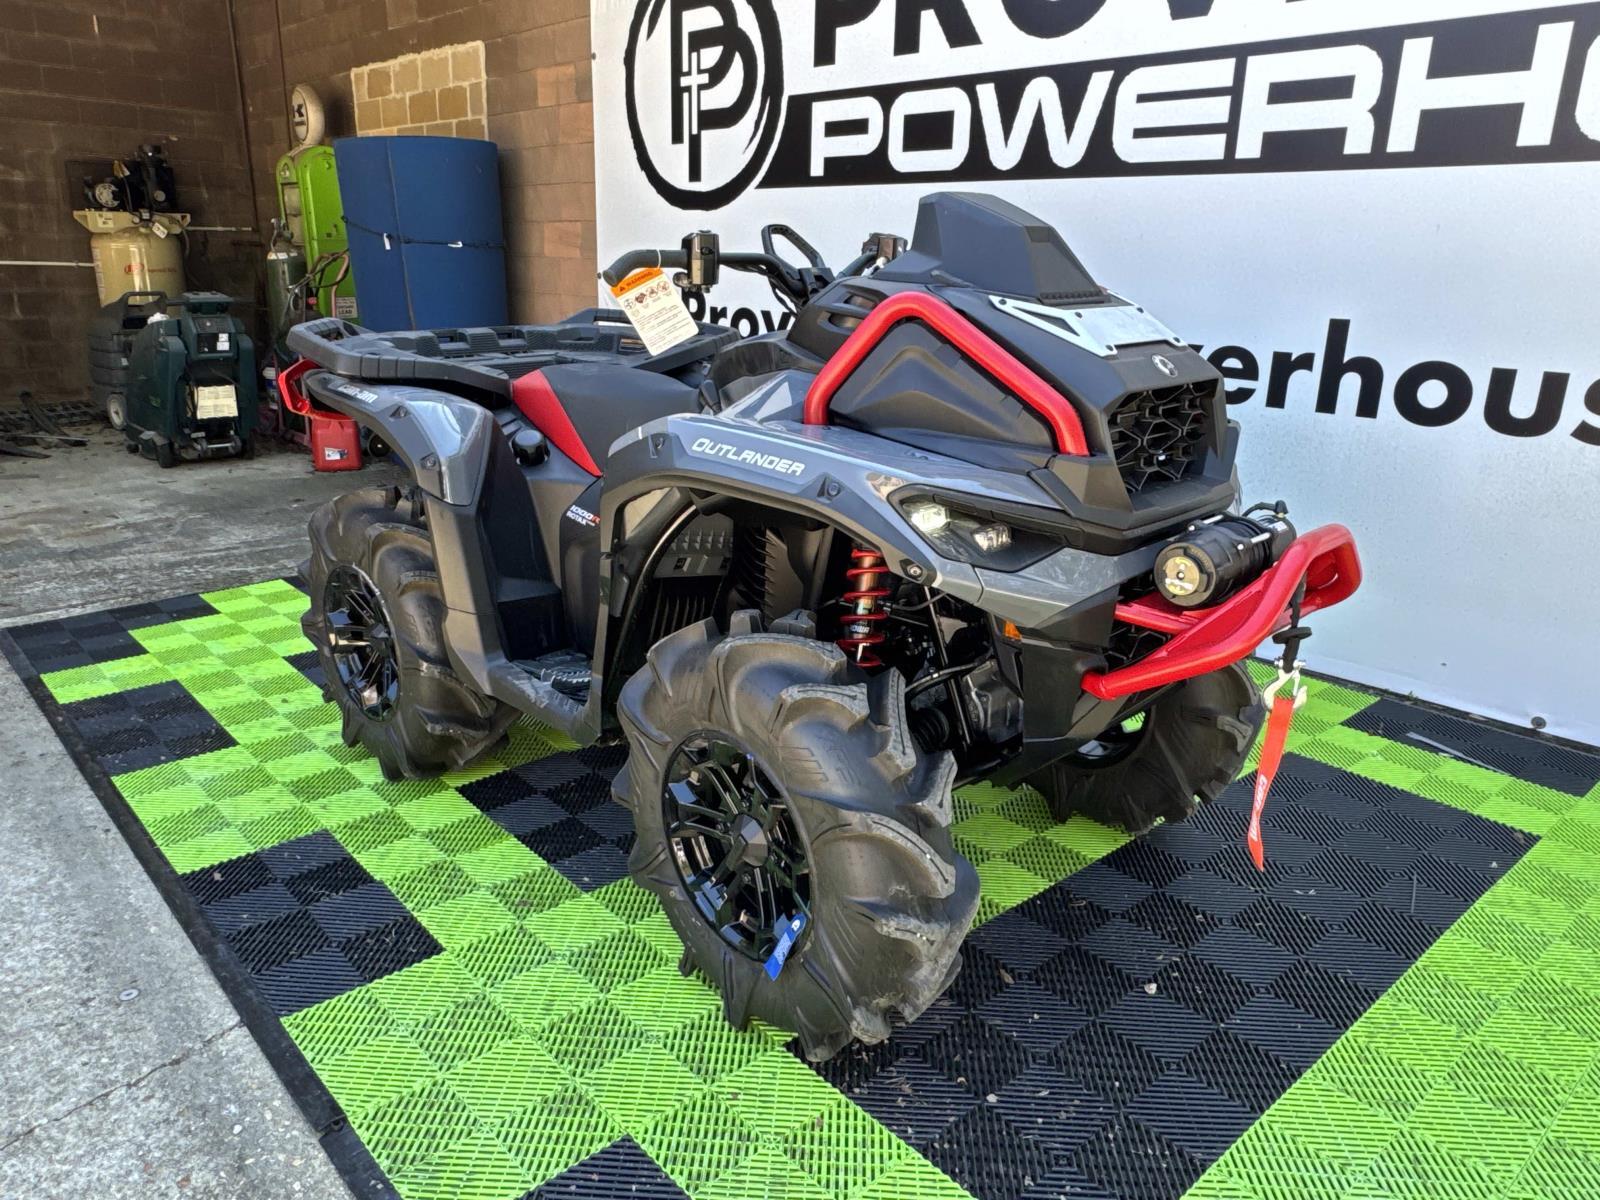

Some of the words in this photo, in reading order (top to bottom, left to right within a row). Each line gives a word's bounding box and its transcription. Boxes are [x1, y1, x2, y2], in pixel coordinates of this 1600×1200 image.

[808, 20, 1600, 177] POWERH
[1187, 318, 1600, 446] erhou
[691, 437, 806, 476] OUTLANDER
